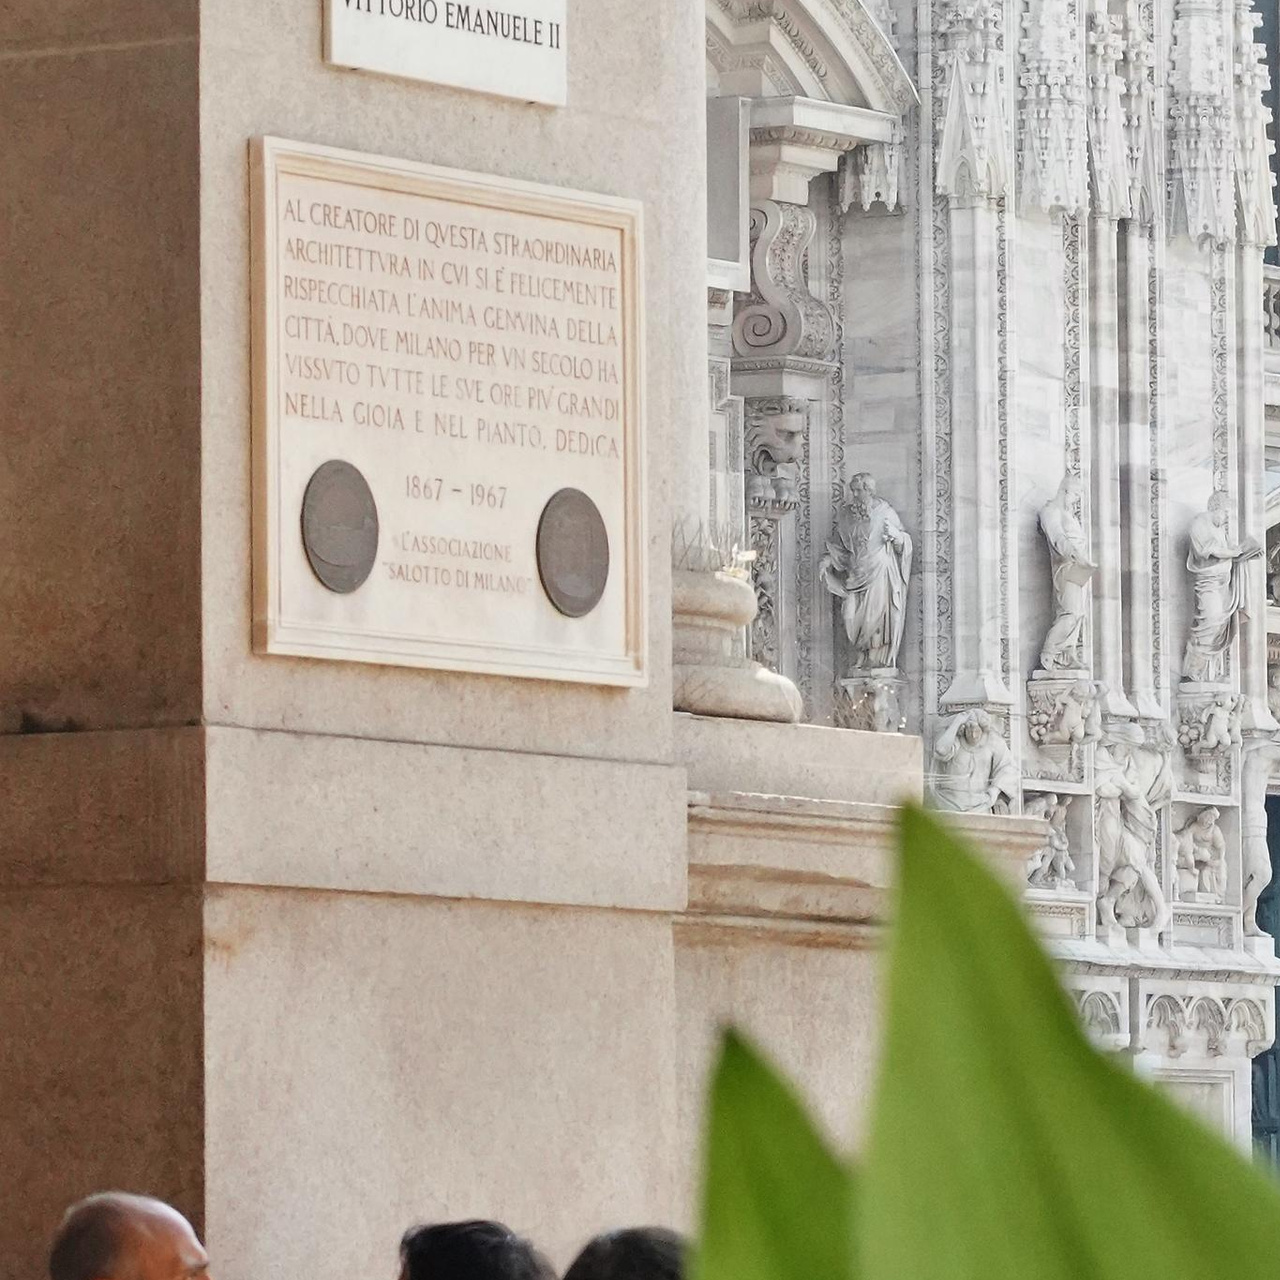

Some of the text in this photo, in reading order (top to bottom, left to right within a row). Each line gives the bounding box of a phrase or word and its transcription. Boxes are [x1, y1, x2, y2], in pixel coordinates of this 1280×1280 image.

[445, 2, 543, 46] EMANUELE
[549, 22, 560, 50] II
[283, 199, 617, 273] AL CREATORE DI QVESTA STRAORDINARIA
[418, 257, 435, 281] IN
[440, 261, 468, 287] CVI
[475, 267, 488, 291] SI
[510, 272, 617, 310] FELICEMENTE
[284, 275, 400, 315] RISPECCHIATA
[407, 293, 477, 327] L'ANIMA
[566, 318, 618, 347] DELLA
[342, 322, 389, 352] DOVE
[395, 330, 462, 362] MILANO
[468, 341, 496, 367] PER
[531, 350, 593, 380] SECOLO
[598, 359, 619, 385] HA
[431, 373, 449, 398] LE
[489, 383, 522, 408] ORE
[557, 392, 619, 421] GRANDI
[285, 391, 343, 423] NELLA
[353, 401, 405, 431] GIOIA
[415, 409, 424, 433] E
[434, 412, 468, 439] NEL
[555, 428, 620, 459] DEDICA
[405, 475, 443, 502] 1867
[470, 482, 508, 509] 1967
[401, 530, 512, 563] L'ASSOCIAZIONE
[456, 570, 469, 589] DI
